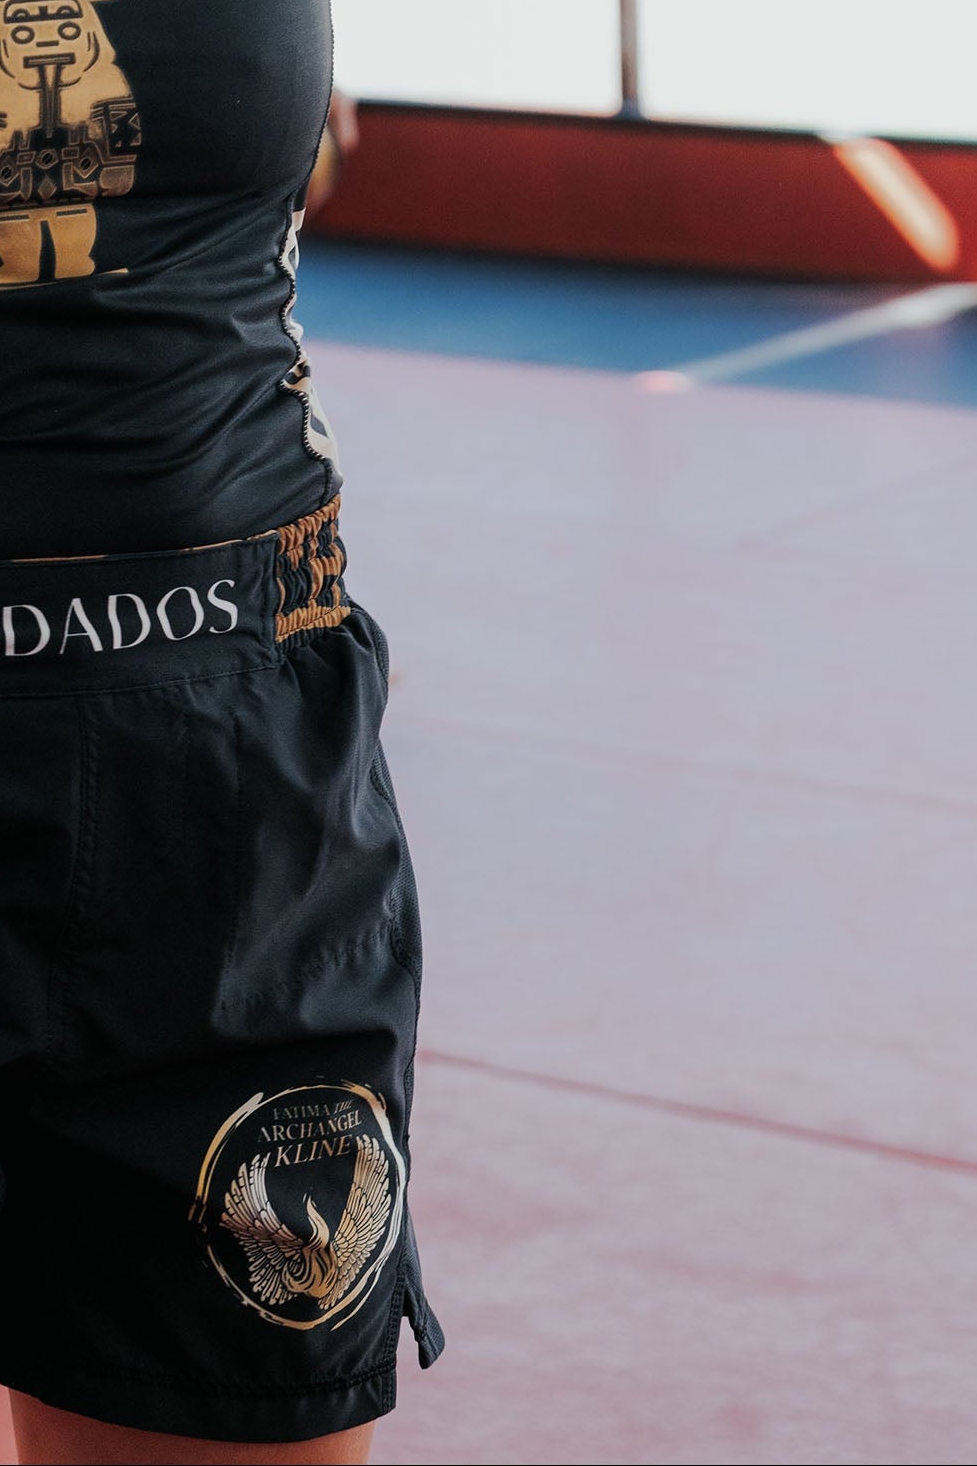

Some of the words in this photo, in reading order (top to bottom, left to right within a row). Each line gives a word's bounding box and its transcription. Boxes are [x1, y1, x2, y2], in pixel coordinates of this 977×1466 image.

[257, 1109, 362, 1142] ARCHANGEL
[273, 1104, 330, 1120] FATIMA
[334, 1100, 354, 1113] THE
[274, 1134, 353, 1167] KLINE
